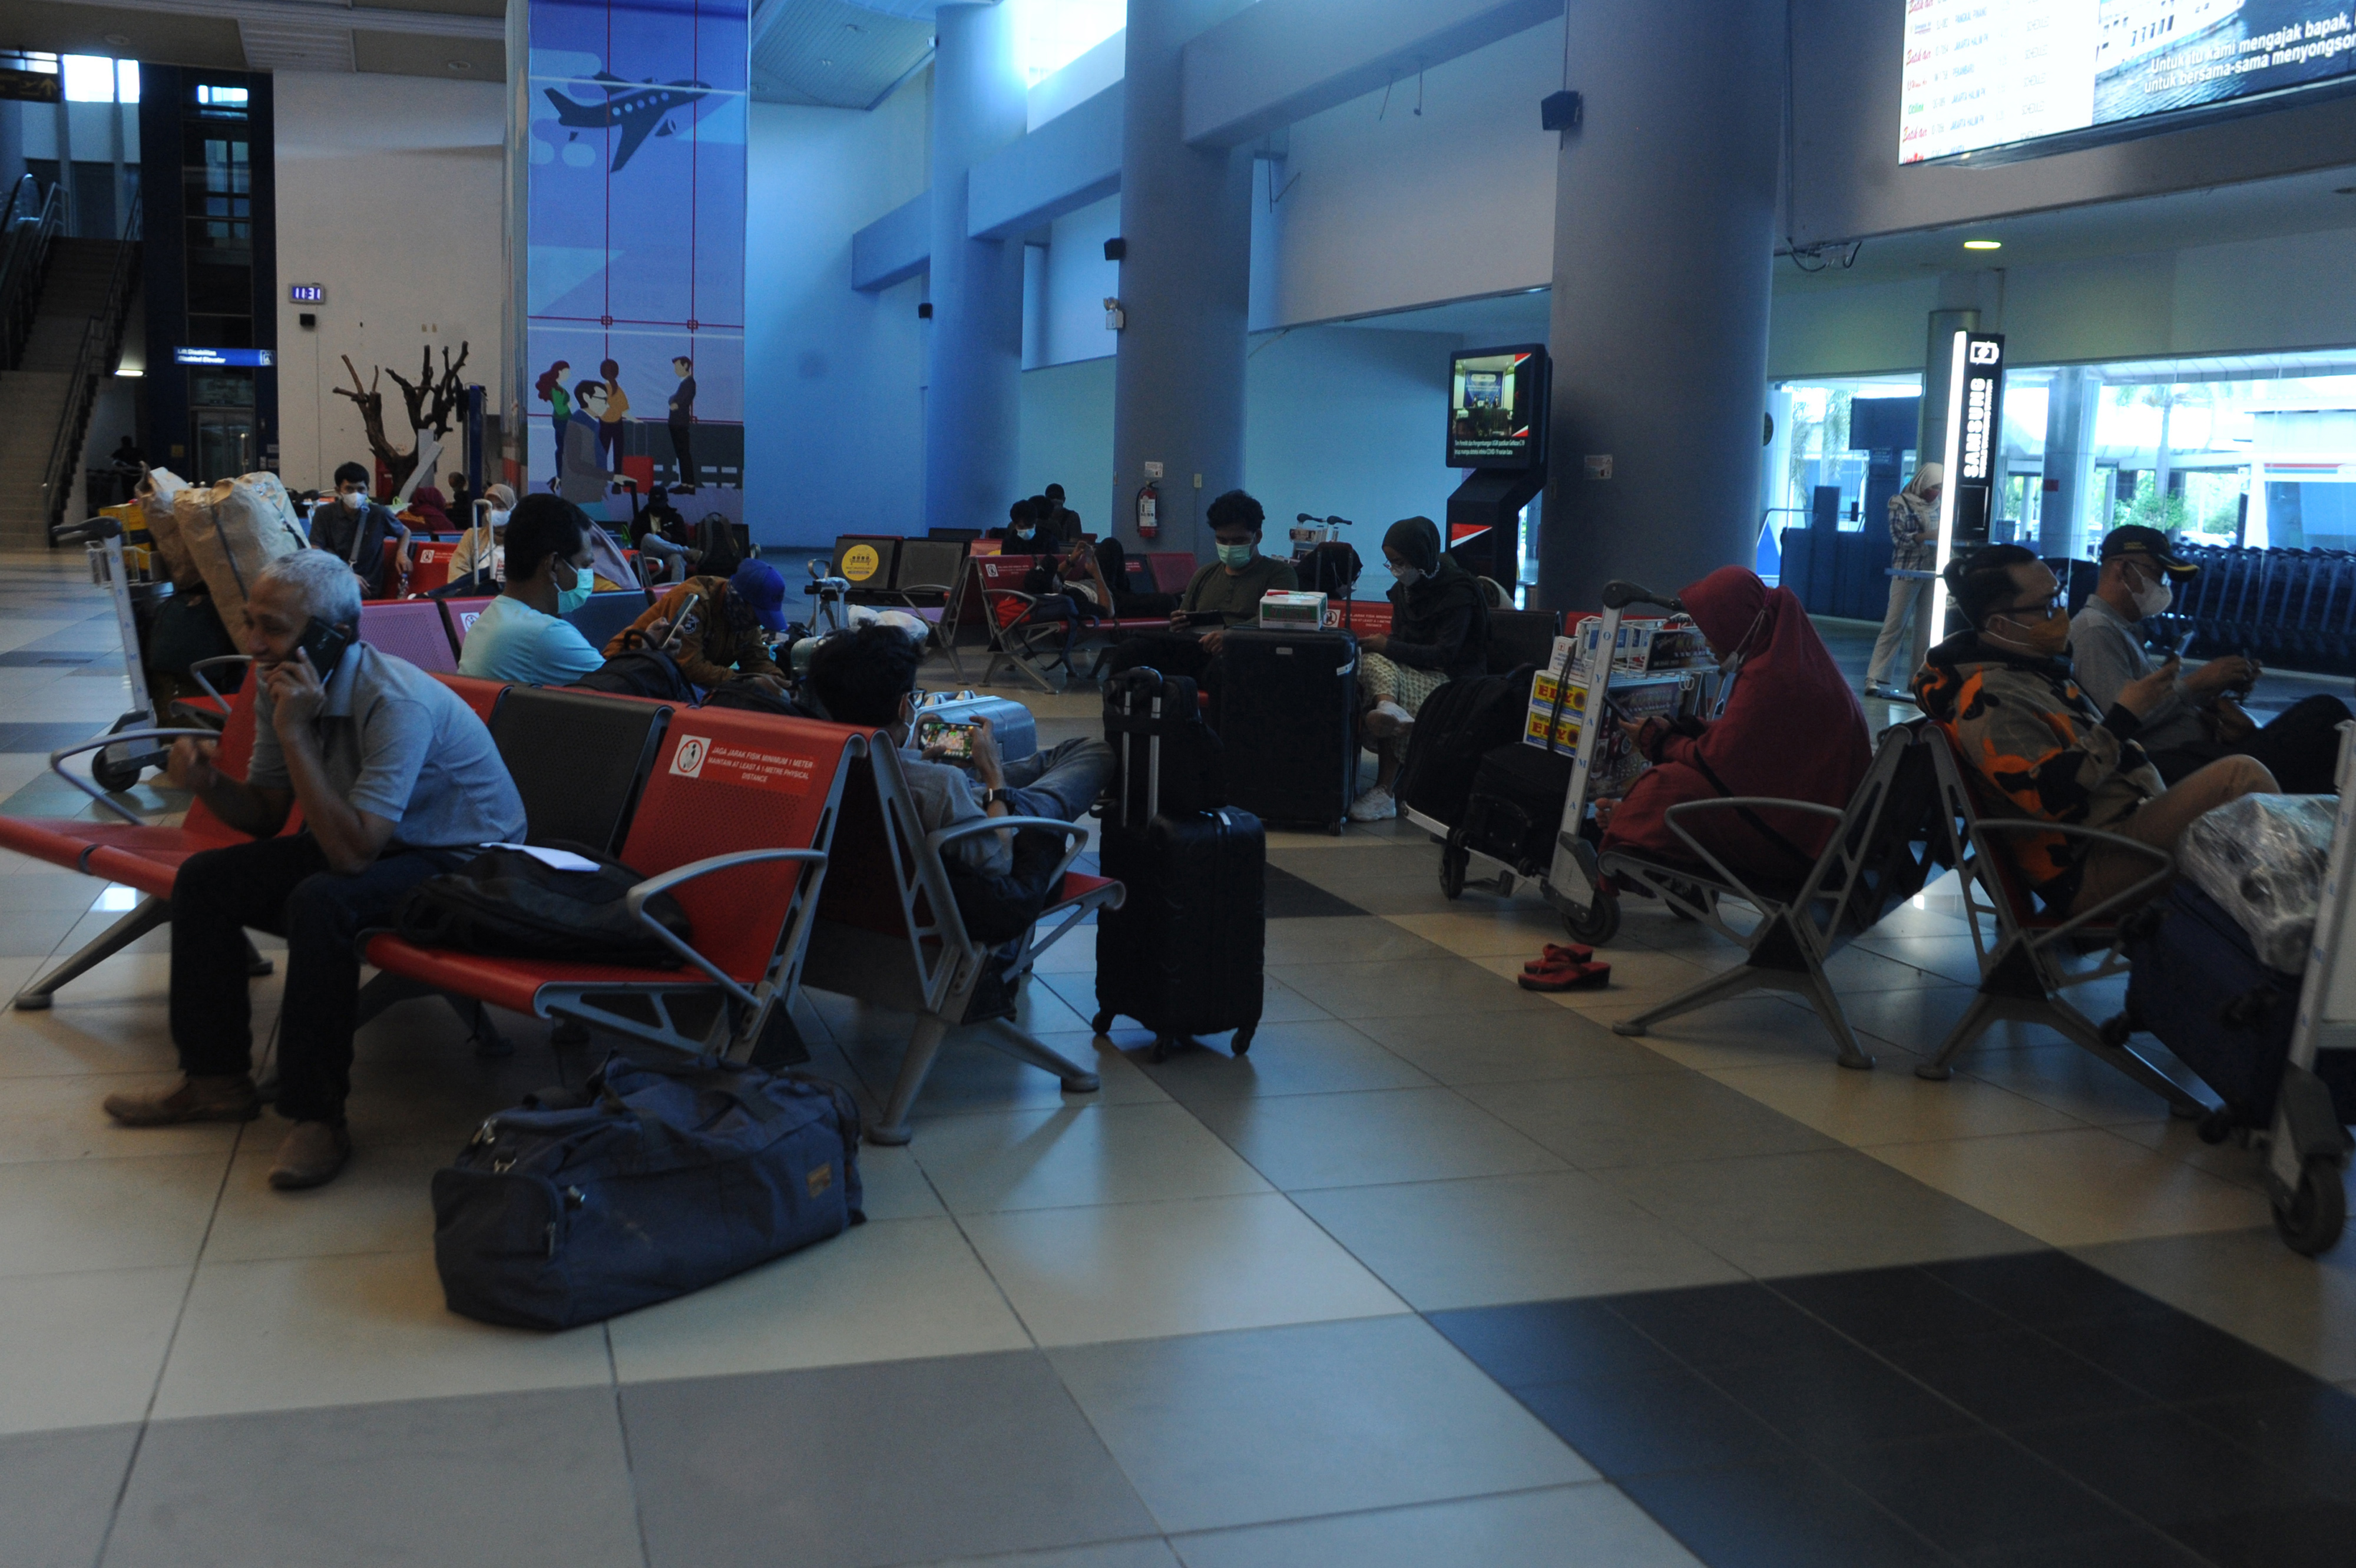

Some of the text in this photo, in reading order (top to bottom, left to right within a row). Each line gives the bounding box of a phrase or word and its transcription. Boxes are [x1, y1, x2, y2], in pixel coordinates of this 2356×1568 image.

[2151, 11, 2352, 74] Untuk itu kami mengajak bapak,
[2145, 74, 2176, 92] untuk
[2179, 55, 2269, 85] bersama-sama
[1963, 378, 1986, 478] SAMSUNG
[707, 757, 733, 766] MAINTAIN
[739, 762, 757, 771] LEAST
[761, 766, 784, 776] 1-METRE
[783, 769, 809, 780] PHYSICAL
[712, 747, 727, 755] JAGA
[727, 749, 746, 758] JARAK
[746, 752, 762, 760] FISIK
[761, 754, 788, 765] MINIMUM
[793, 759, 814, 769] METER
[741, 772, 769, 782] DISTANCE
